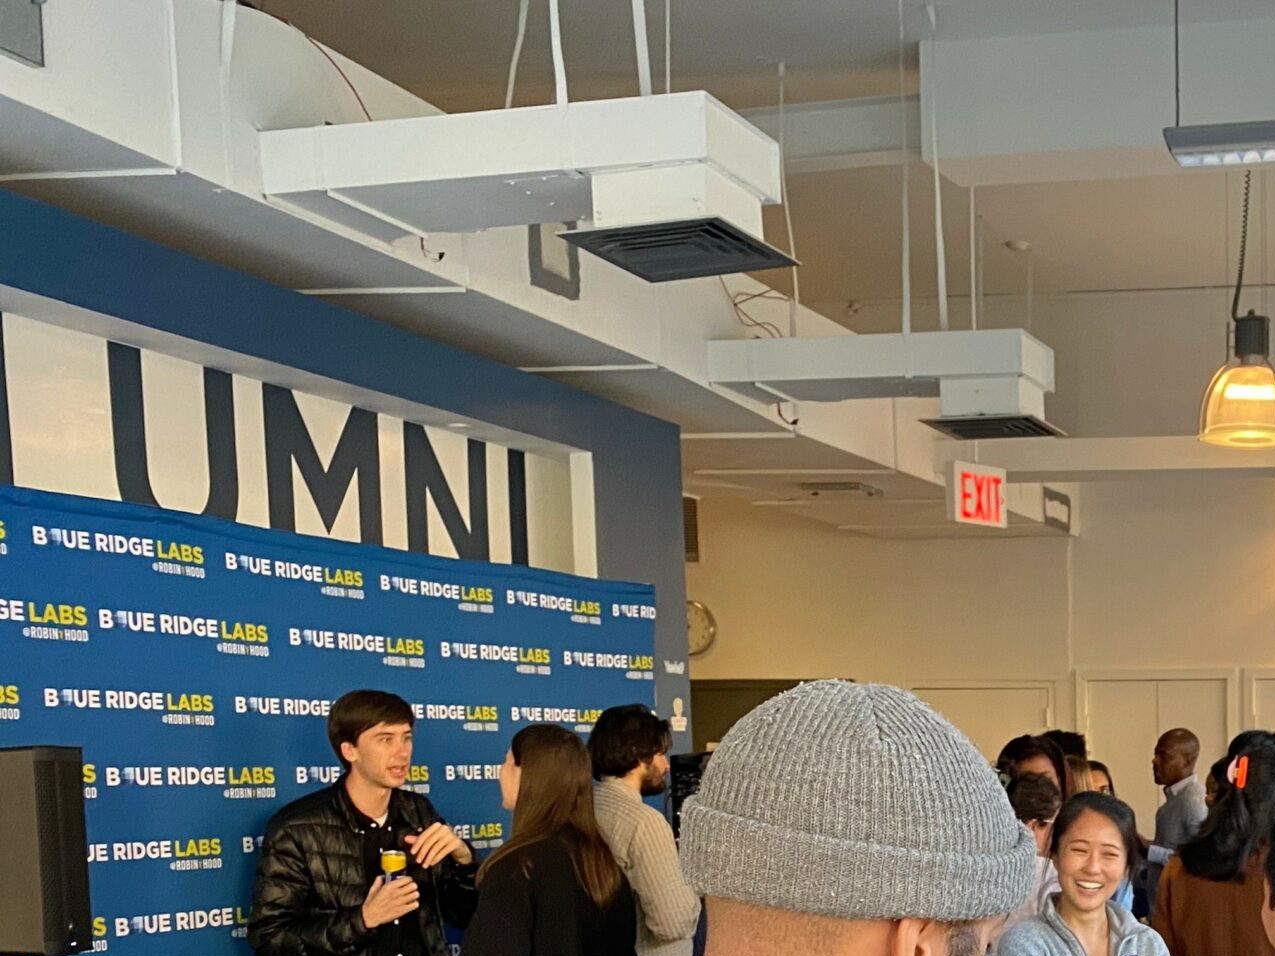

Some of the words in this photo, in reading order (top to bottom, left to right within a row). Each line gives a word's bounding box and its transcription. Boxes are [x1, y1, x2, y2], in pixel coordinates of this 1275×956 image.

[960, 472, 1002, 522] EXIT
[95, 533, 154, 557] RIDGE
[157, 540, 204, 564] LABS
[275, 561, 322, 582] RIDGE
[325, 568, 363, 587] LABS
[420, 581, 460, 599] RIDGE
[461, 586, 493, 602] LABS
[29, 602, 87, 626] LABS
[540, 594, 573, 611] RIDGE
[574, 600, 600, 615] LABS
[160, 614, 218, 637] RIDGE
[221, 621, 268, 643] LABS
[338, 633, 384, 652] RIDGE
[387, 638, 424, 655] LABS
[480, 645, 518, 661] RIDGE
[519, 648, 550, 663] LABS
[596, 654, 628, 668] RIDGE
[629, 656, 653, 669] LABS
[106, 691, 164, 710] RIDGE
[167, 694, 213, 712] LABS
[284, 699, 330, 716] RIDGE
[427, 705, 465, 719] RIDGE
[467, 706, 497, 720] LABS
[544, 708, 576, 722] RIDGE
[168, 767, 225, 785] RIDGE
[229, 767, 275, 784] LABS
[472, 823, 502, 838] LABS
[113, 841, 172, 860] RIDGE
[175, 839, 221, 857] LABS
[176, 908, 233, 929] RIDGE
